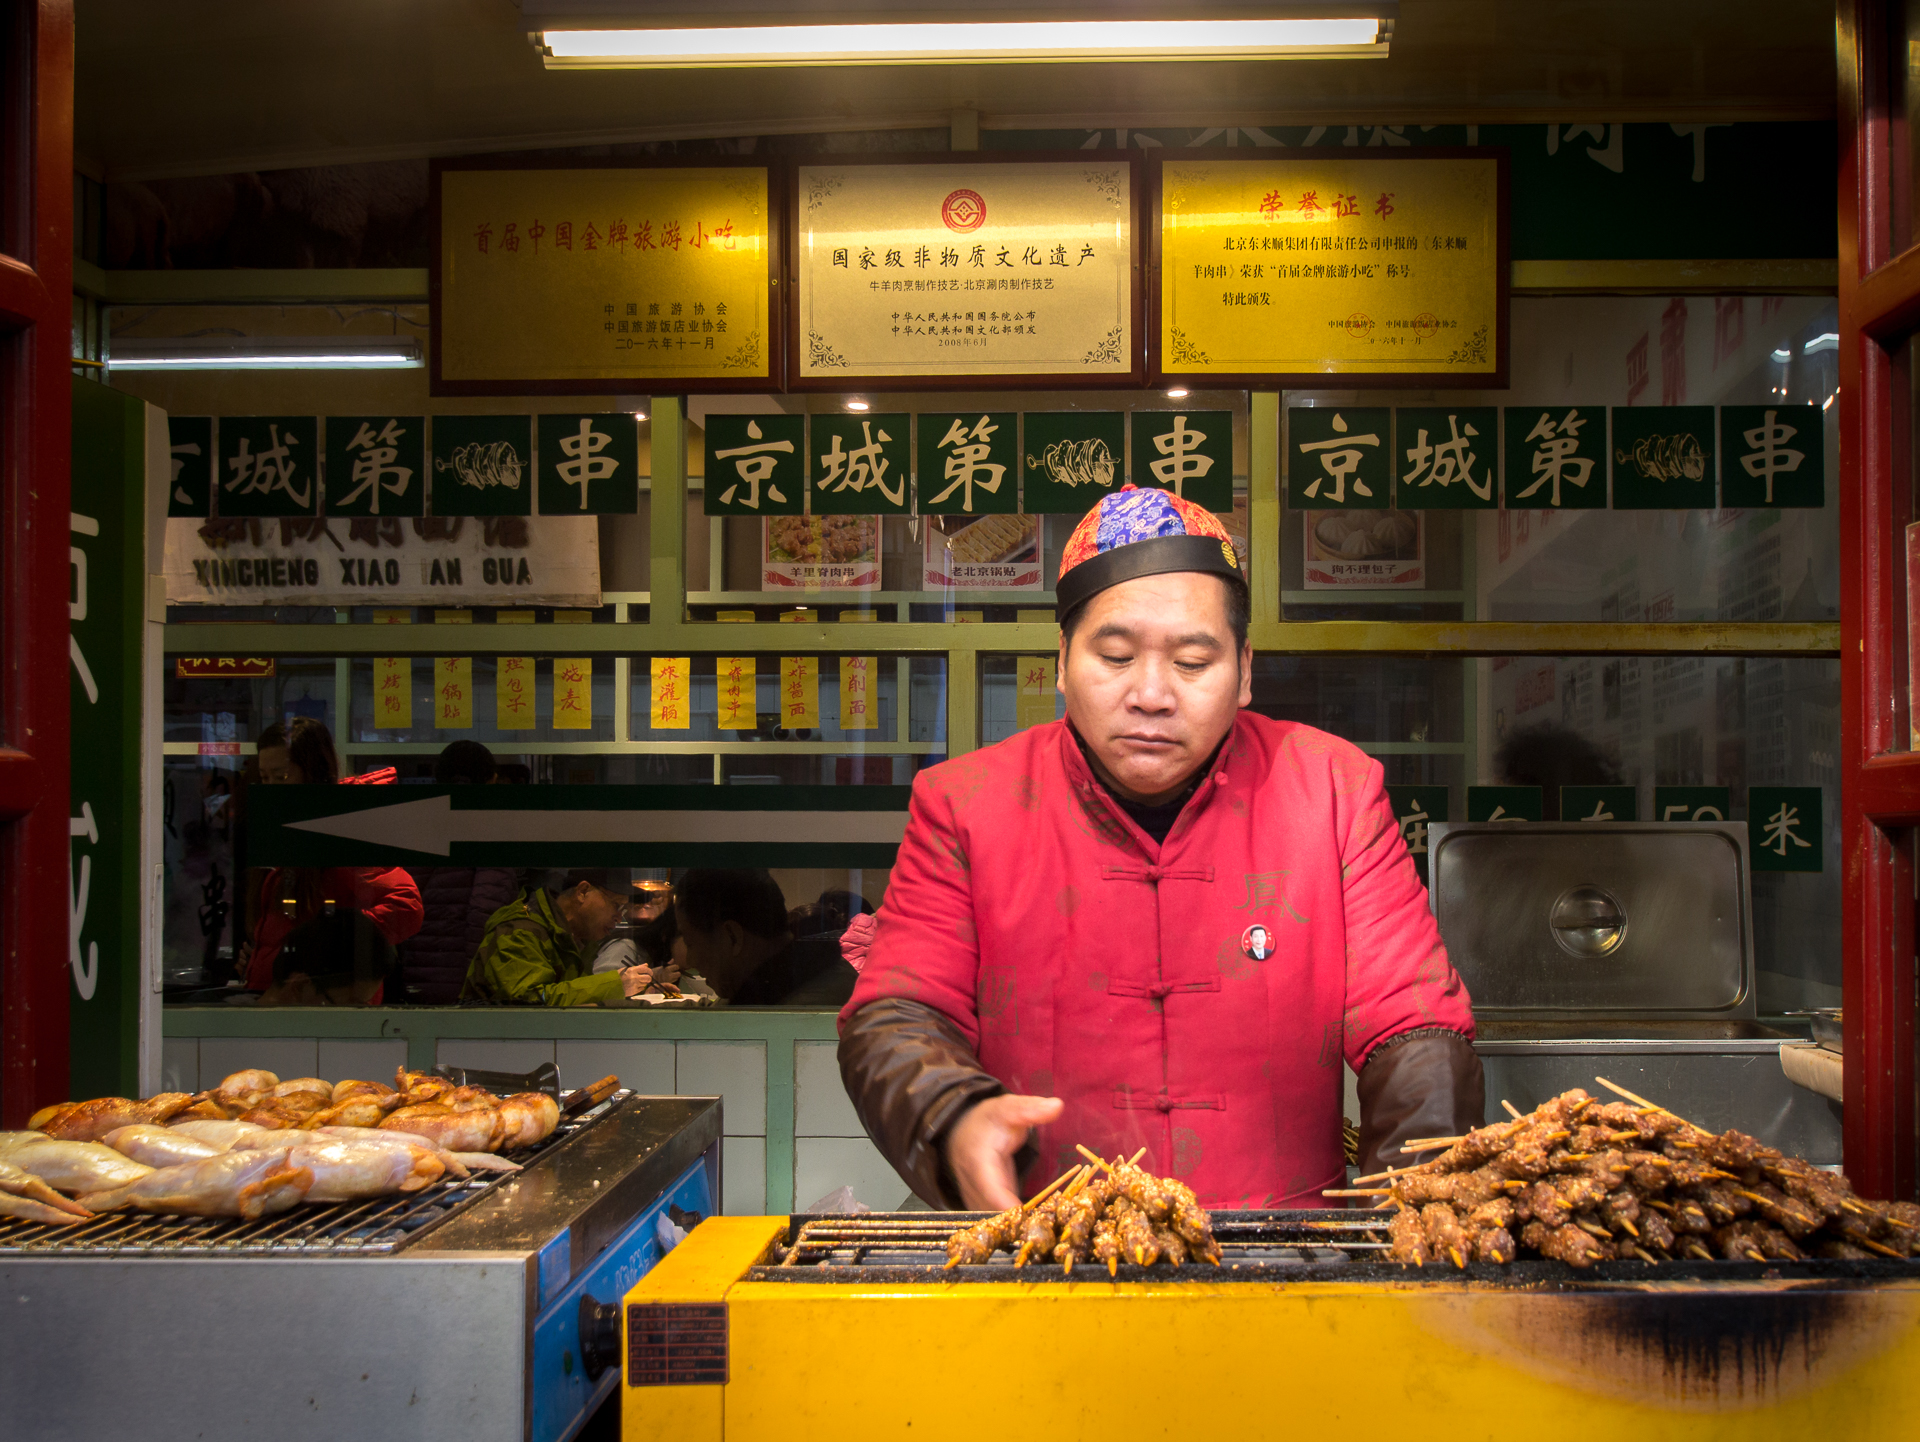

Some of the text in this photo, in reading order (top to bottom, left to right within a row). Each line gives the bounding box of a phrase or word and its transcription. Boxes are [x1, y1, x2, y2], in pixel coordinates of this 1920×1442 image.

[1259, 190, 1396, 222] 荣誉证书
[473, 218, 737, 255] 首届中国金牌旅游小吃
[832, 243, 1096, 270] 国家级非物质文化遗产
[604, 302, 728, 317] 中国旅游协会
[891, 310, 1037, 324] 中华人民共和国国务院公布
[604, 319, 728, 334] 中国旅游饭店业协会
[555, 418, 620, 510] 串
[1149, 415, 1216, 498] 串
[1739, 409, 1806, 503] 串
[192, 558, 320, 588] XINCHENG
[341, 558, 400, 586] XIAO
[790, 567, 855, 577] 羊里脊肉串
[951, 567, 1016, 577] 老北京锅贴
[1331, 564, 1398, 575] 狗不理包子
